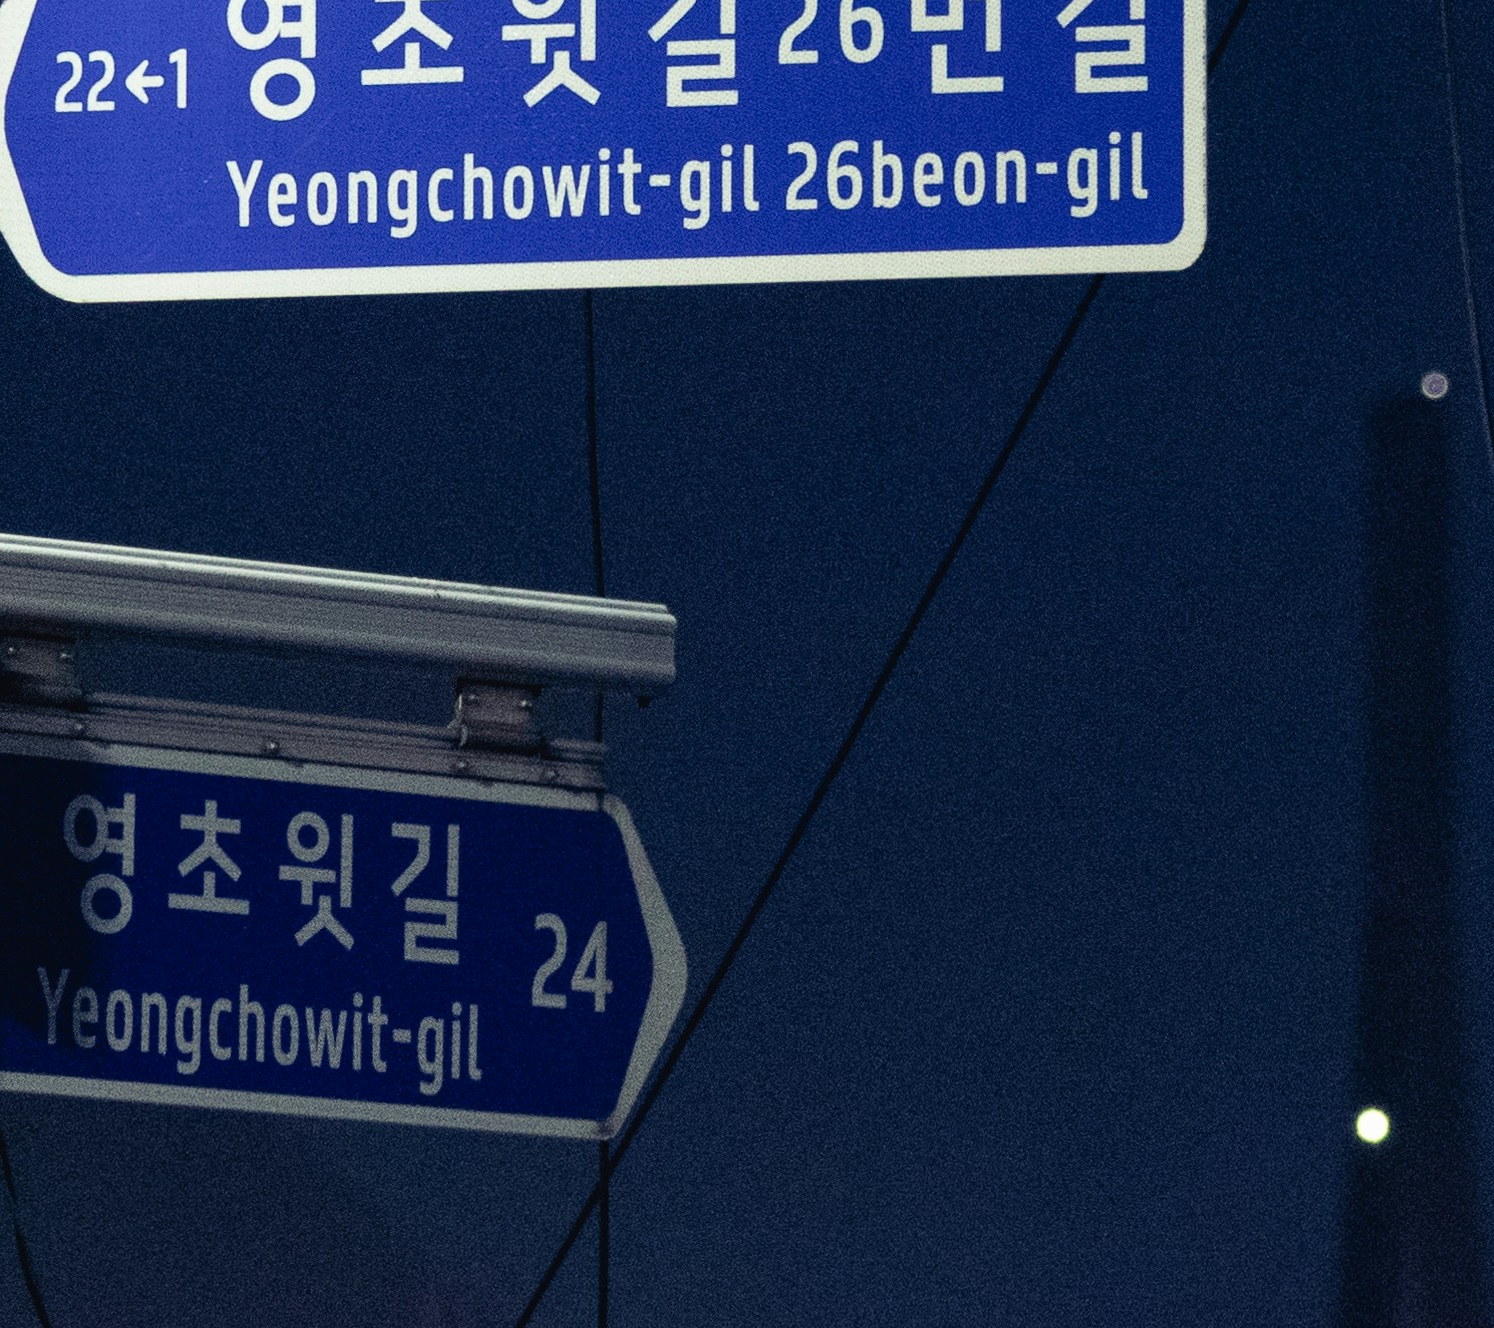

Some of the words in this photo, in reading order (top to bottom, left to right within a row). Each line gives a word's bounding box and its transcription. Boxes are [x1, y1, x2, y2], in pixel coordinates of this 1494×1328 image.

[225, 143, 761, 240] Yeongchowit-gil
[785, 131, 1149, 218] 26beon-gil
[62, 790, 463, 967] 영초윗길
[529, 910, 615, 1015] 24
[36, 966, 484, 1098] Yeongchowit-gil
